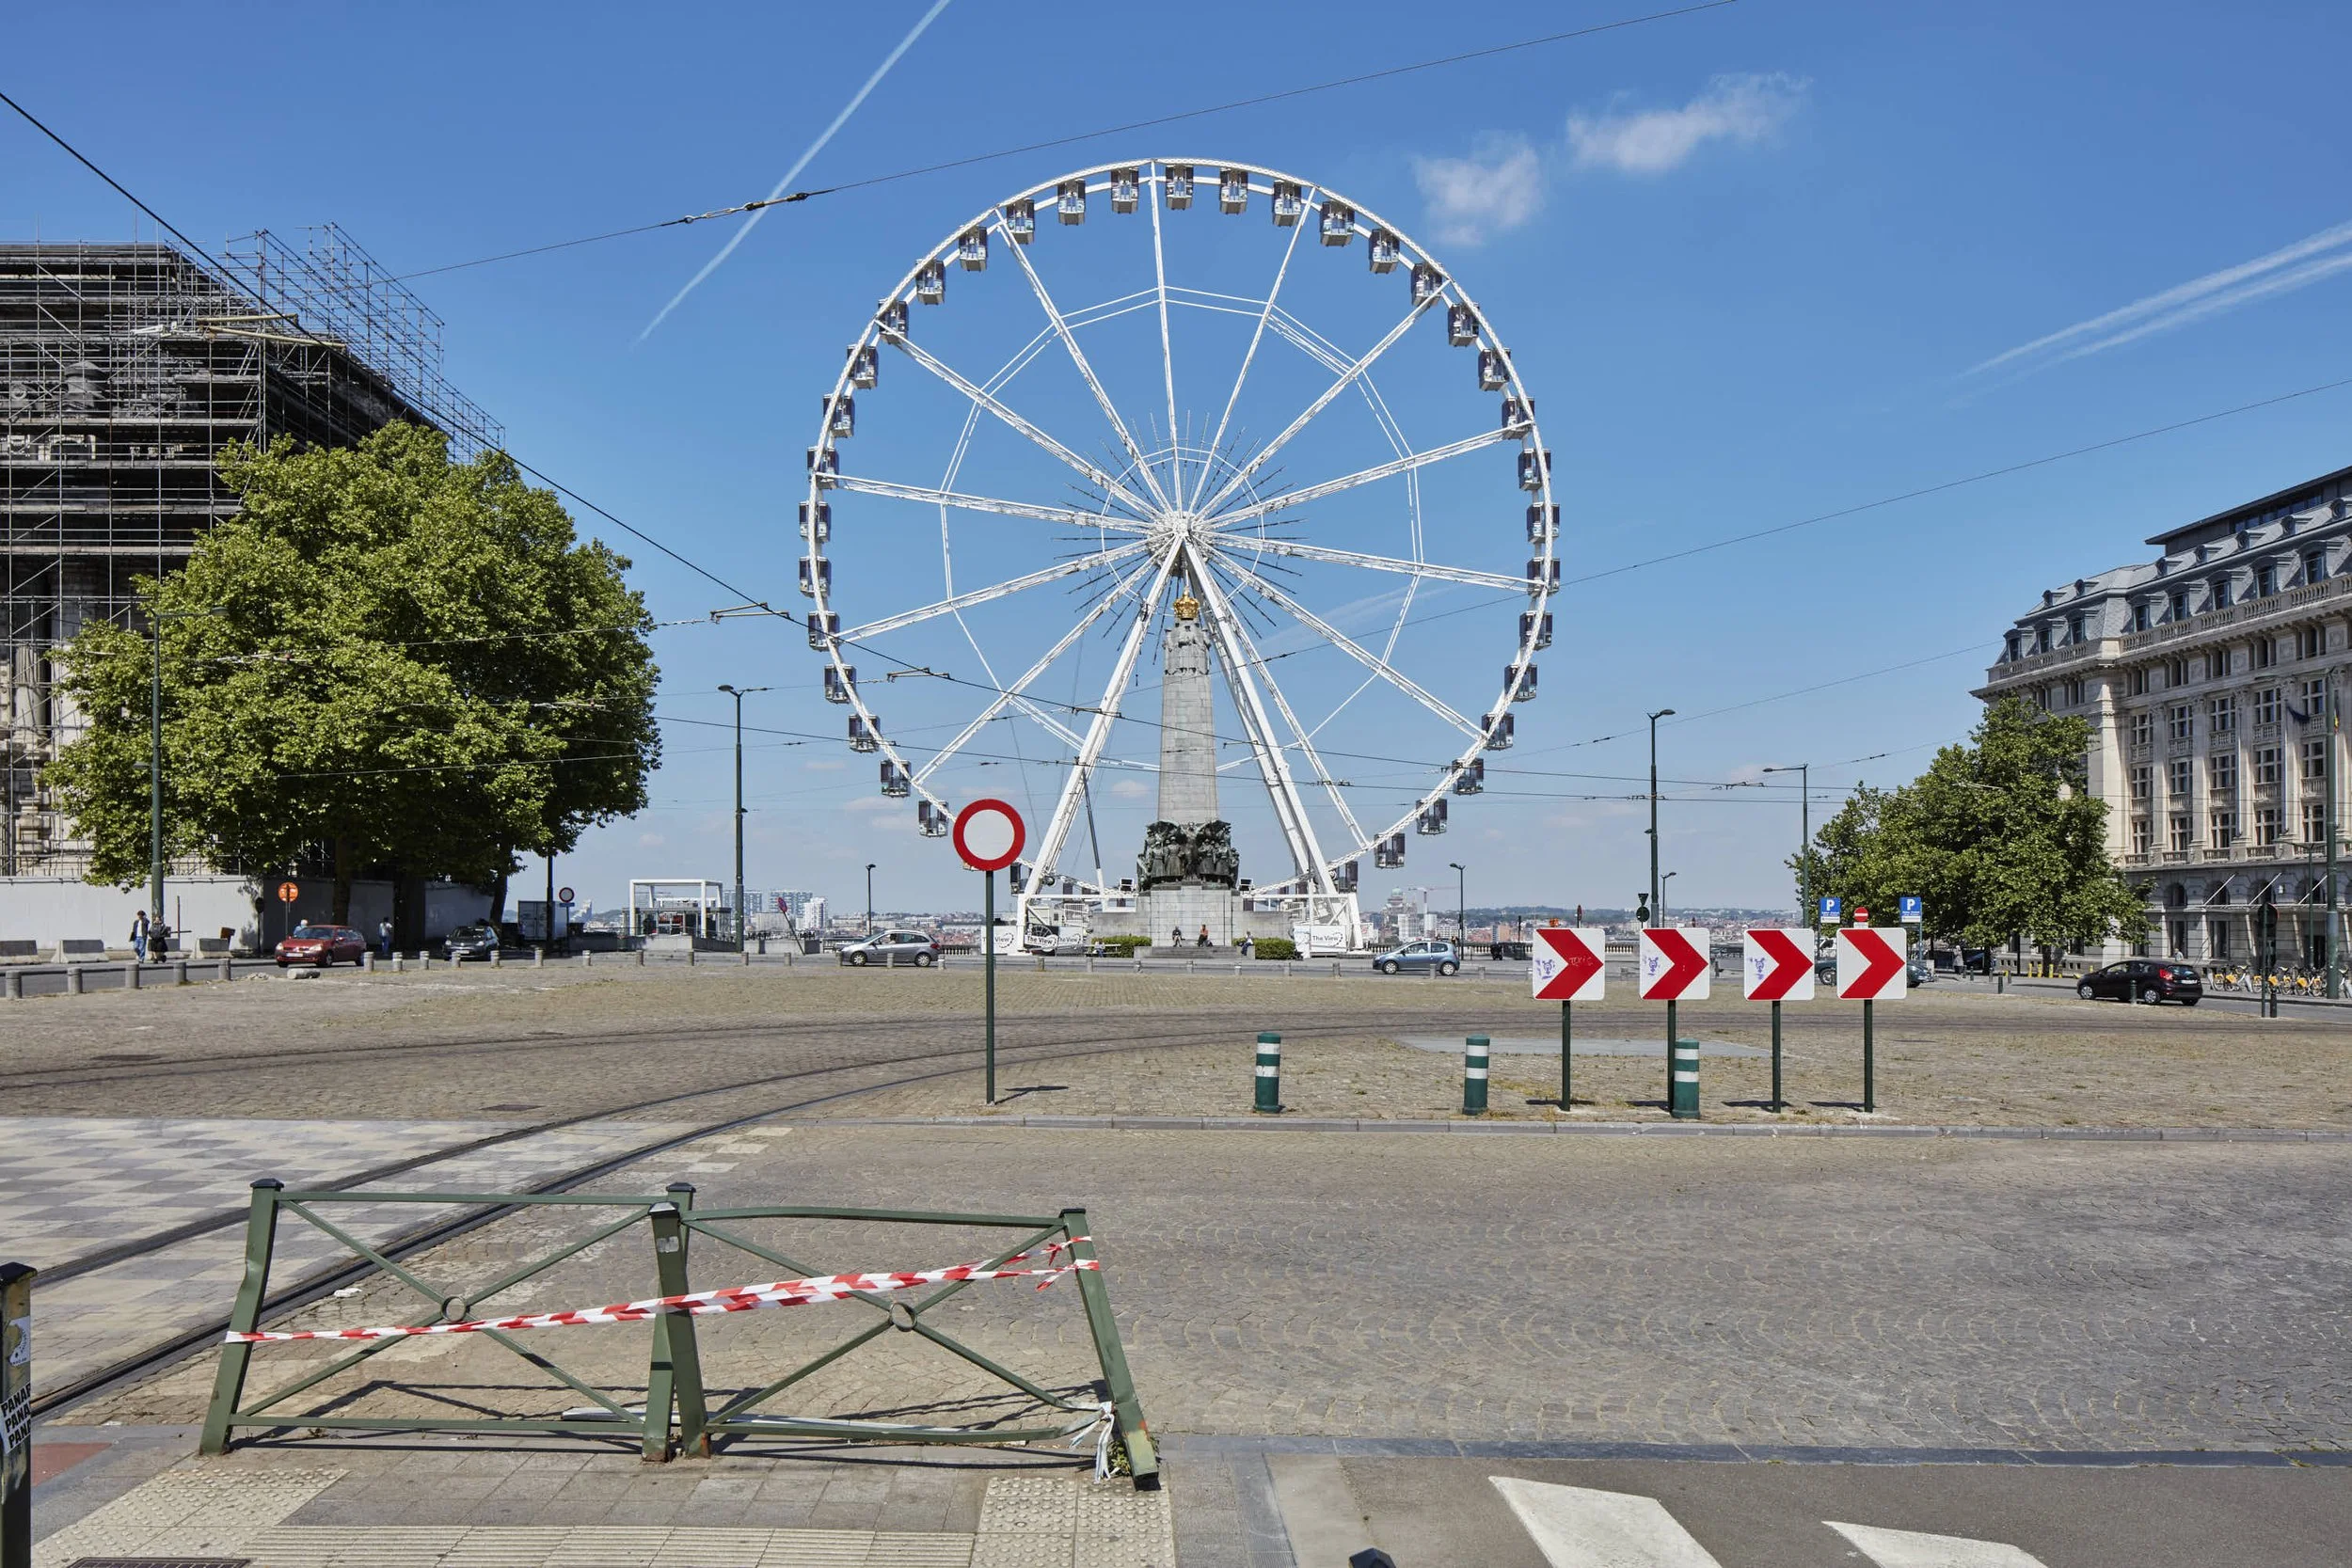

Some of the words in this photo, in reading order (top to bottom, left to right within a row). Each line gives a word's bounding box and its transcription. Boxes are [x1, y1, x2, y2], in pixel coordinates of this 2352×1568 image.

[1826, 899, 1835, 911] P
[1907, 898, 1915, 911] P
[1039, 936, 1053, 944] View
